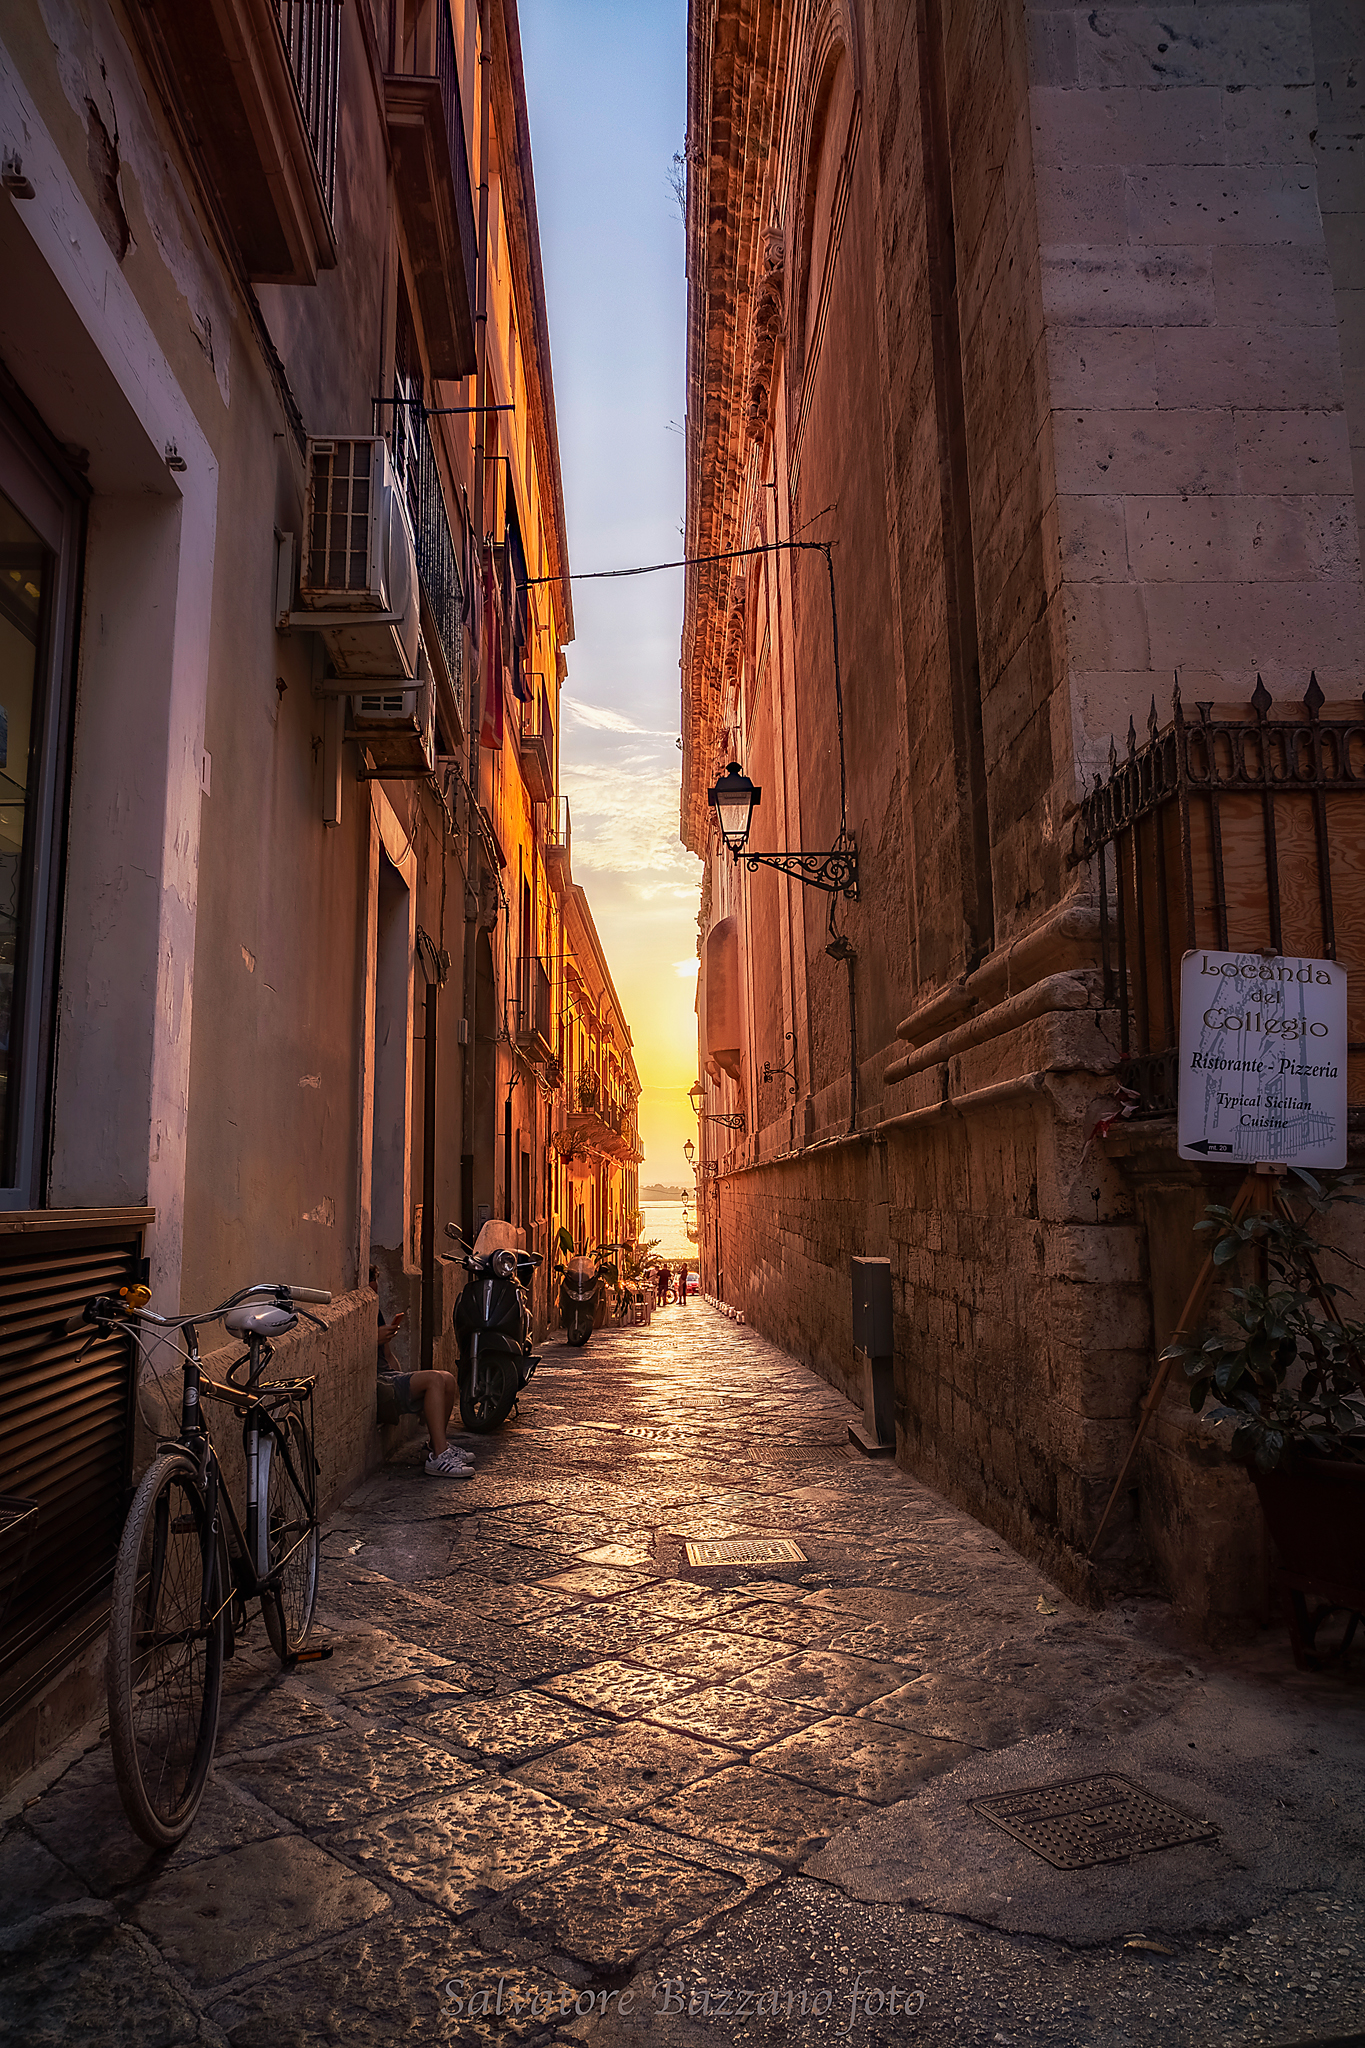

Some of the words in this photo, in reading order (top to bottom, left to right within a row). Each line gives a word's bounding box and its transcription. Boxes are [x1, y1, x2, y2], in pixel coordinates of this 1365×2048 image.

[1200, 955, 1332, 985] Locanda
[1251, 990, 1281, 1005] del
[1203, 1008, 1329, 1040] Collegio
[1190, 1052, 1264, 1073] Ristorante
[1278, 1058, 1338, 1078] Pizzeria
[1217, 1092, 1261, 1108] Typical
[1264, 1095, 1312, 1111] Sicilian
[1240, 1114, 1288, 1129] Cuisine
